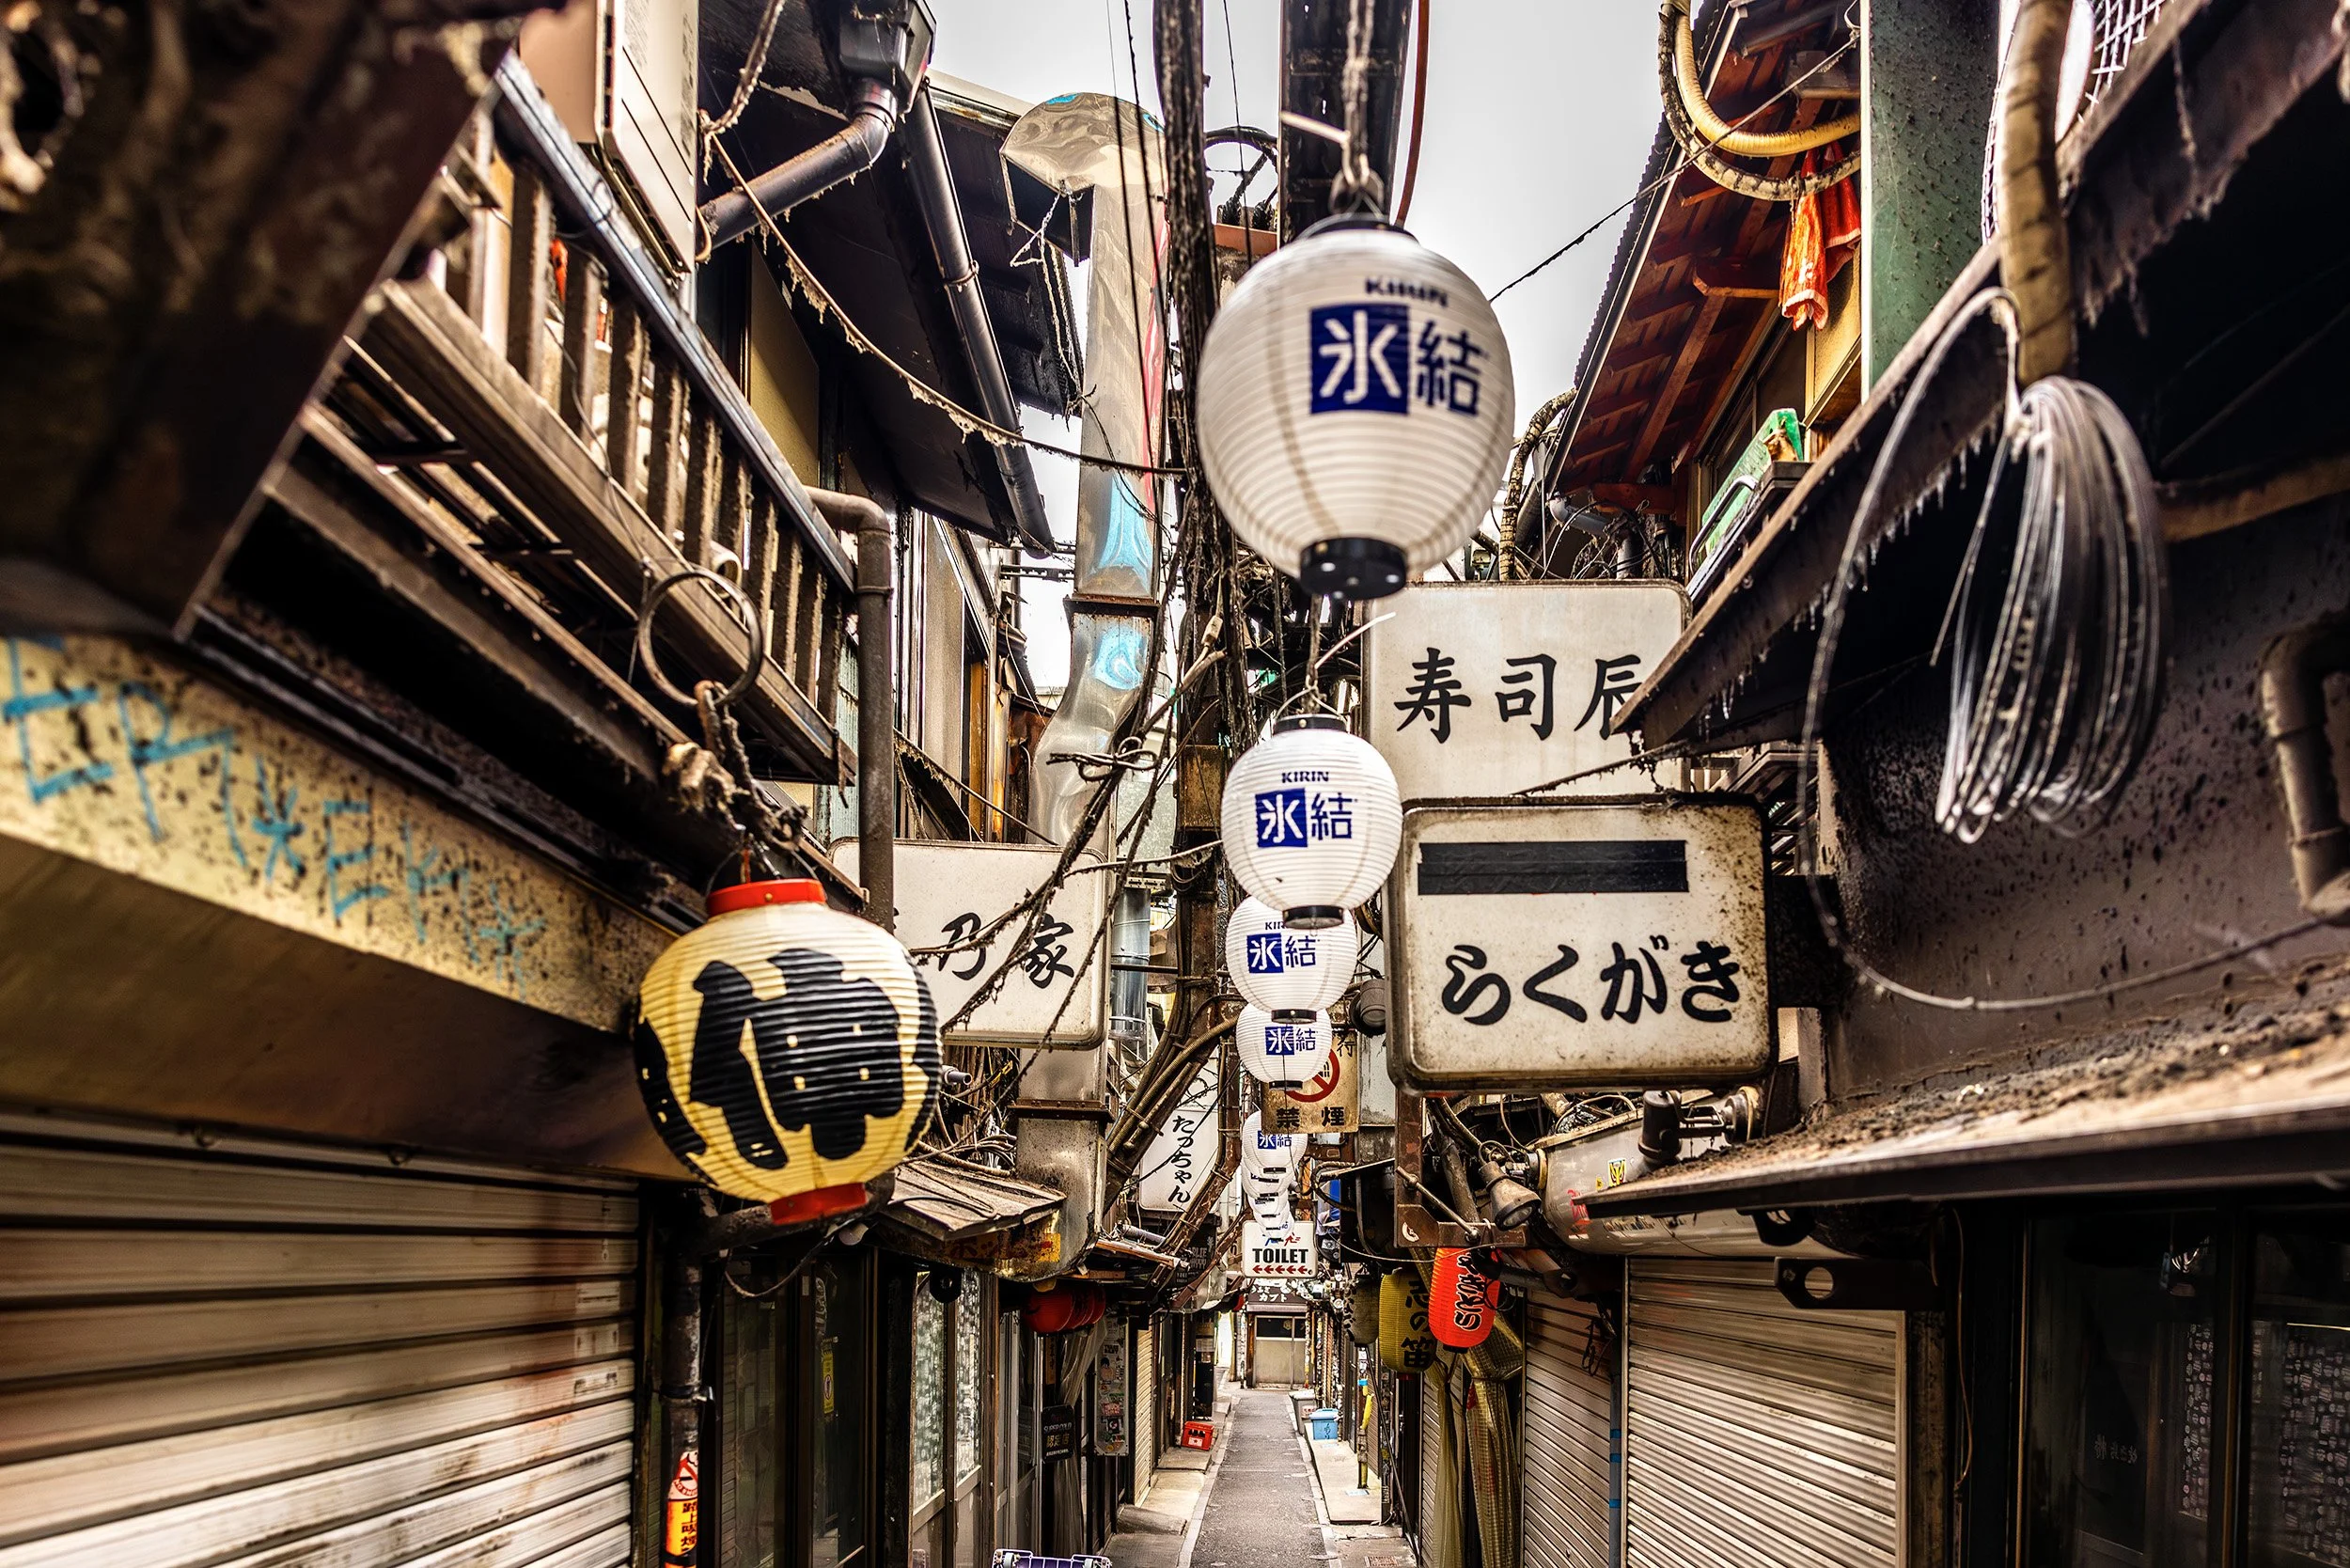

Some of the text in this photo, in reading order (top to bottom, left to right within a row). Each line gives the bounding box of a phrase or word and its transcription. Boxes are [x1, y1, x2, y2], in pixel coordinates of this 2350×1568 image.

[1317, 307, 1489, 417] 氷結
[1281, 771, 1330, 784] KIRIN
[1259, 792, 1353, 844] 氷結
[1264, 921, 1285, 931] KIR
[893, 907, 1074, 990] 乃家
[1249, 935, 1316, 971] 氷結
[1440, 934, 1741, 1027] らくがき
[1268, 1027, 1317, 1054] 氷結
[1276, 1105, 1346, 1128] 禁煙
[1258, 1131, 1292, 1149] 氷結
[1252, 1247, 1308, 1263] TOILET
